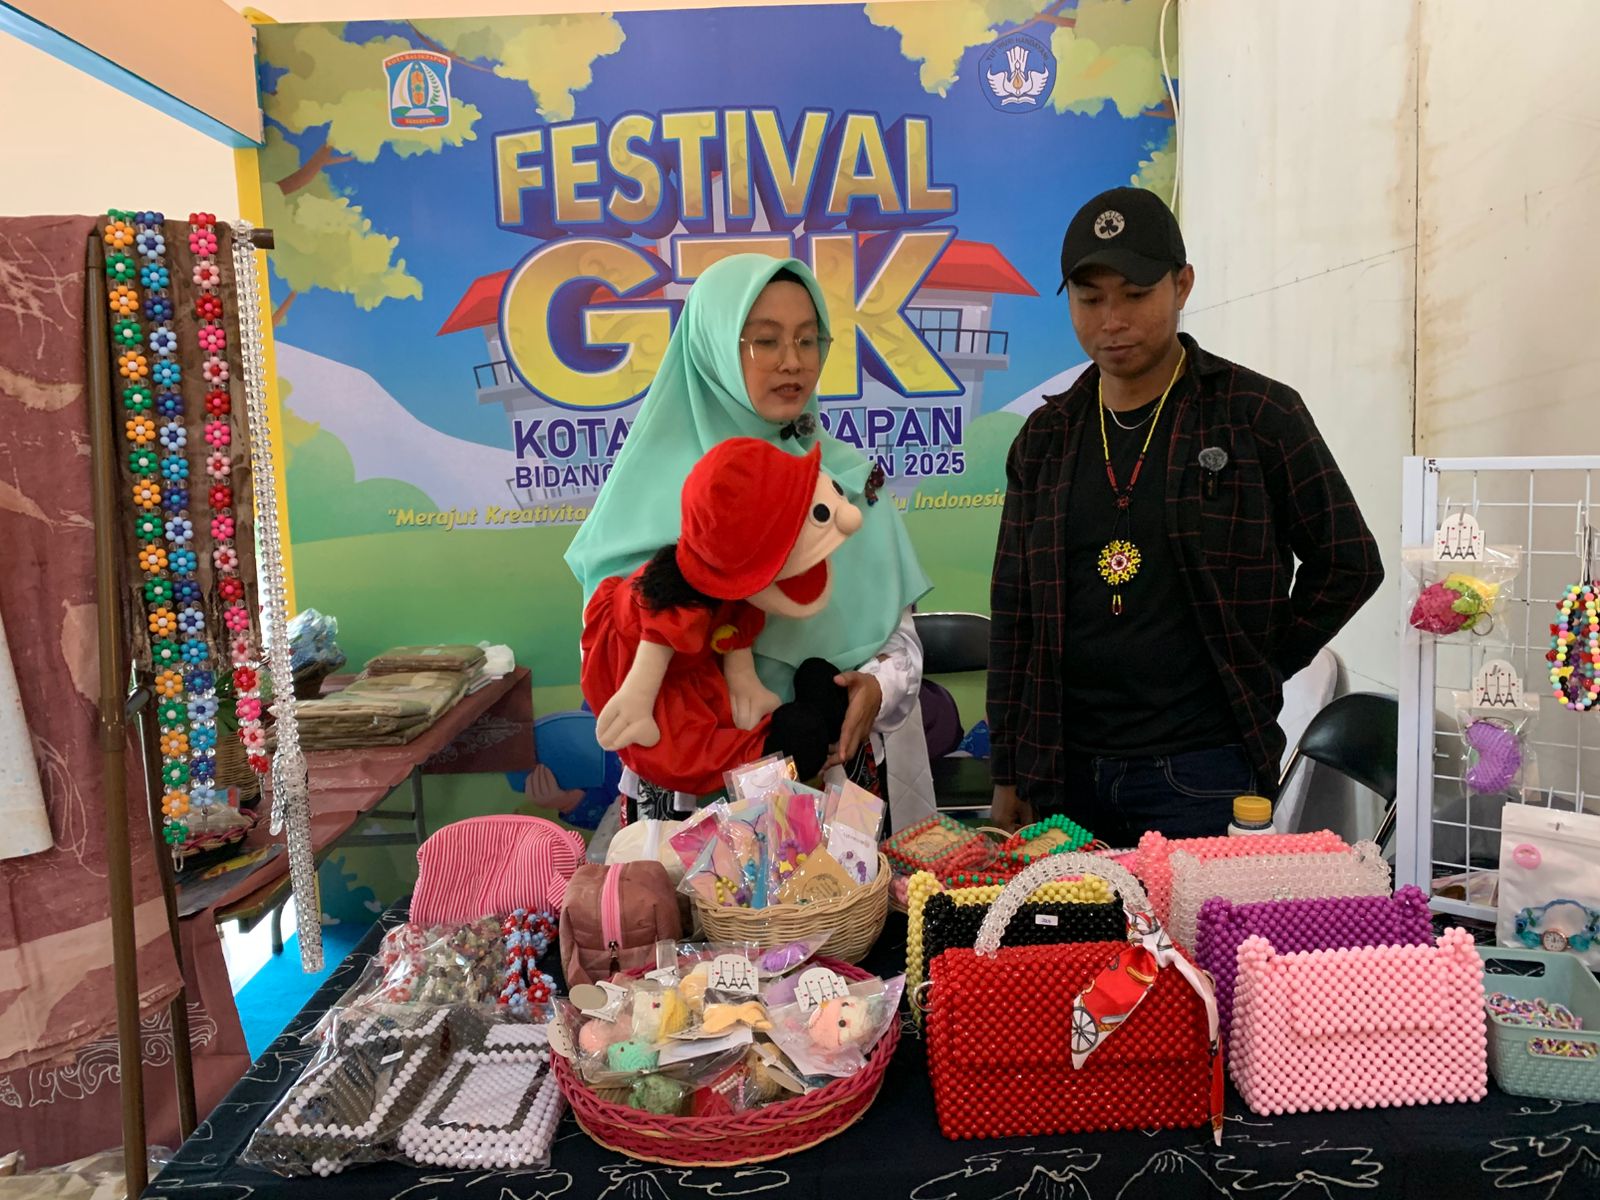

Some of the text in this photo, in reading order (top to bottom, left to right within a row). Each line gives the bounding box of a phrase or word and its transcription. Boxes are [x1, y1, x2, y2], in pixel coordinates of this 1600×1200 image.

[494, 107, 956, 228] FESTIVAL
[500, 228, 966, 410] GK
[513, 417, 631, 460] KOTA
[904, 452, 965, 476] 2025
[387, 506, 478, 531] "Merajut
[484, 503, 589, 525] Kreativita
